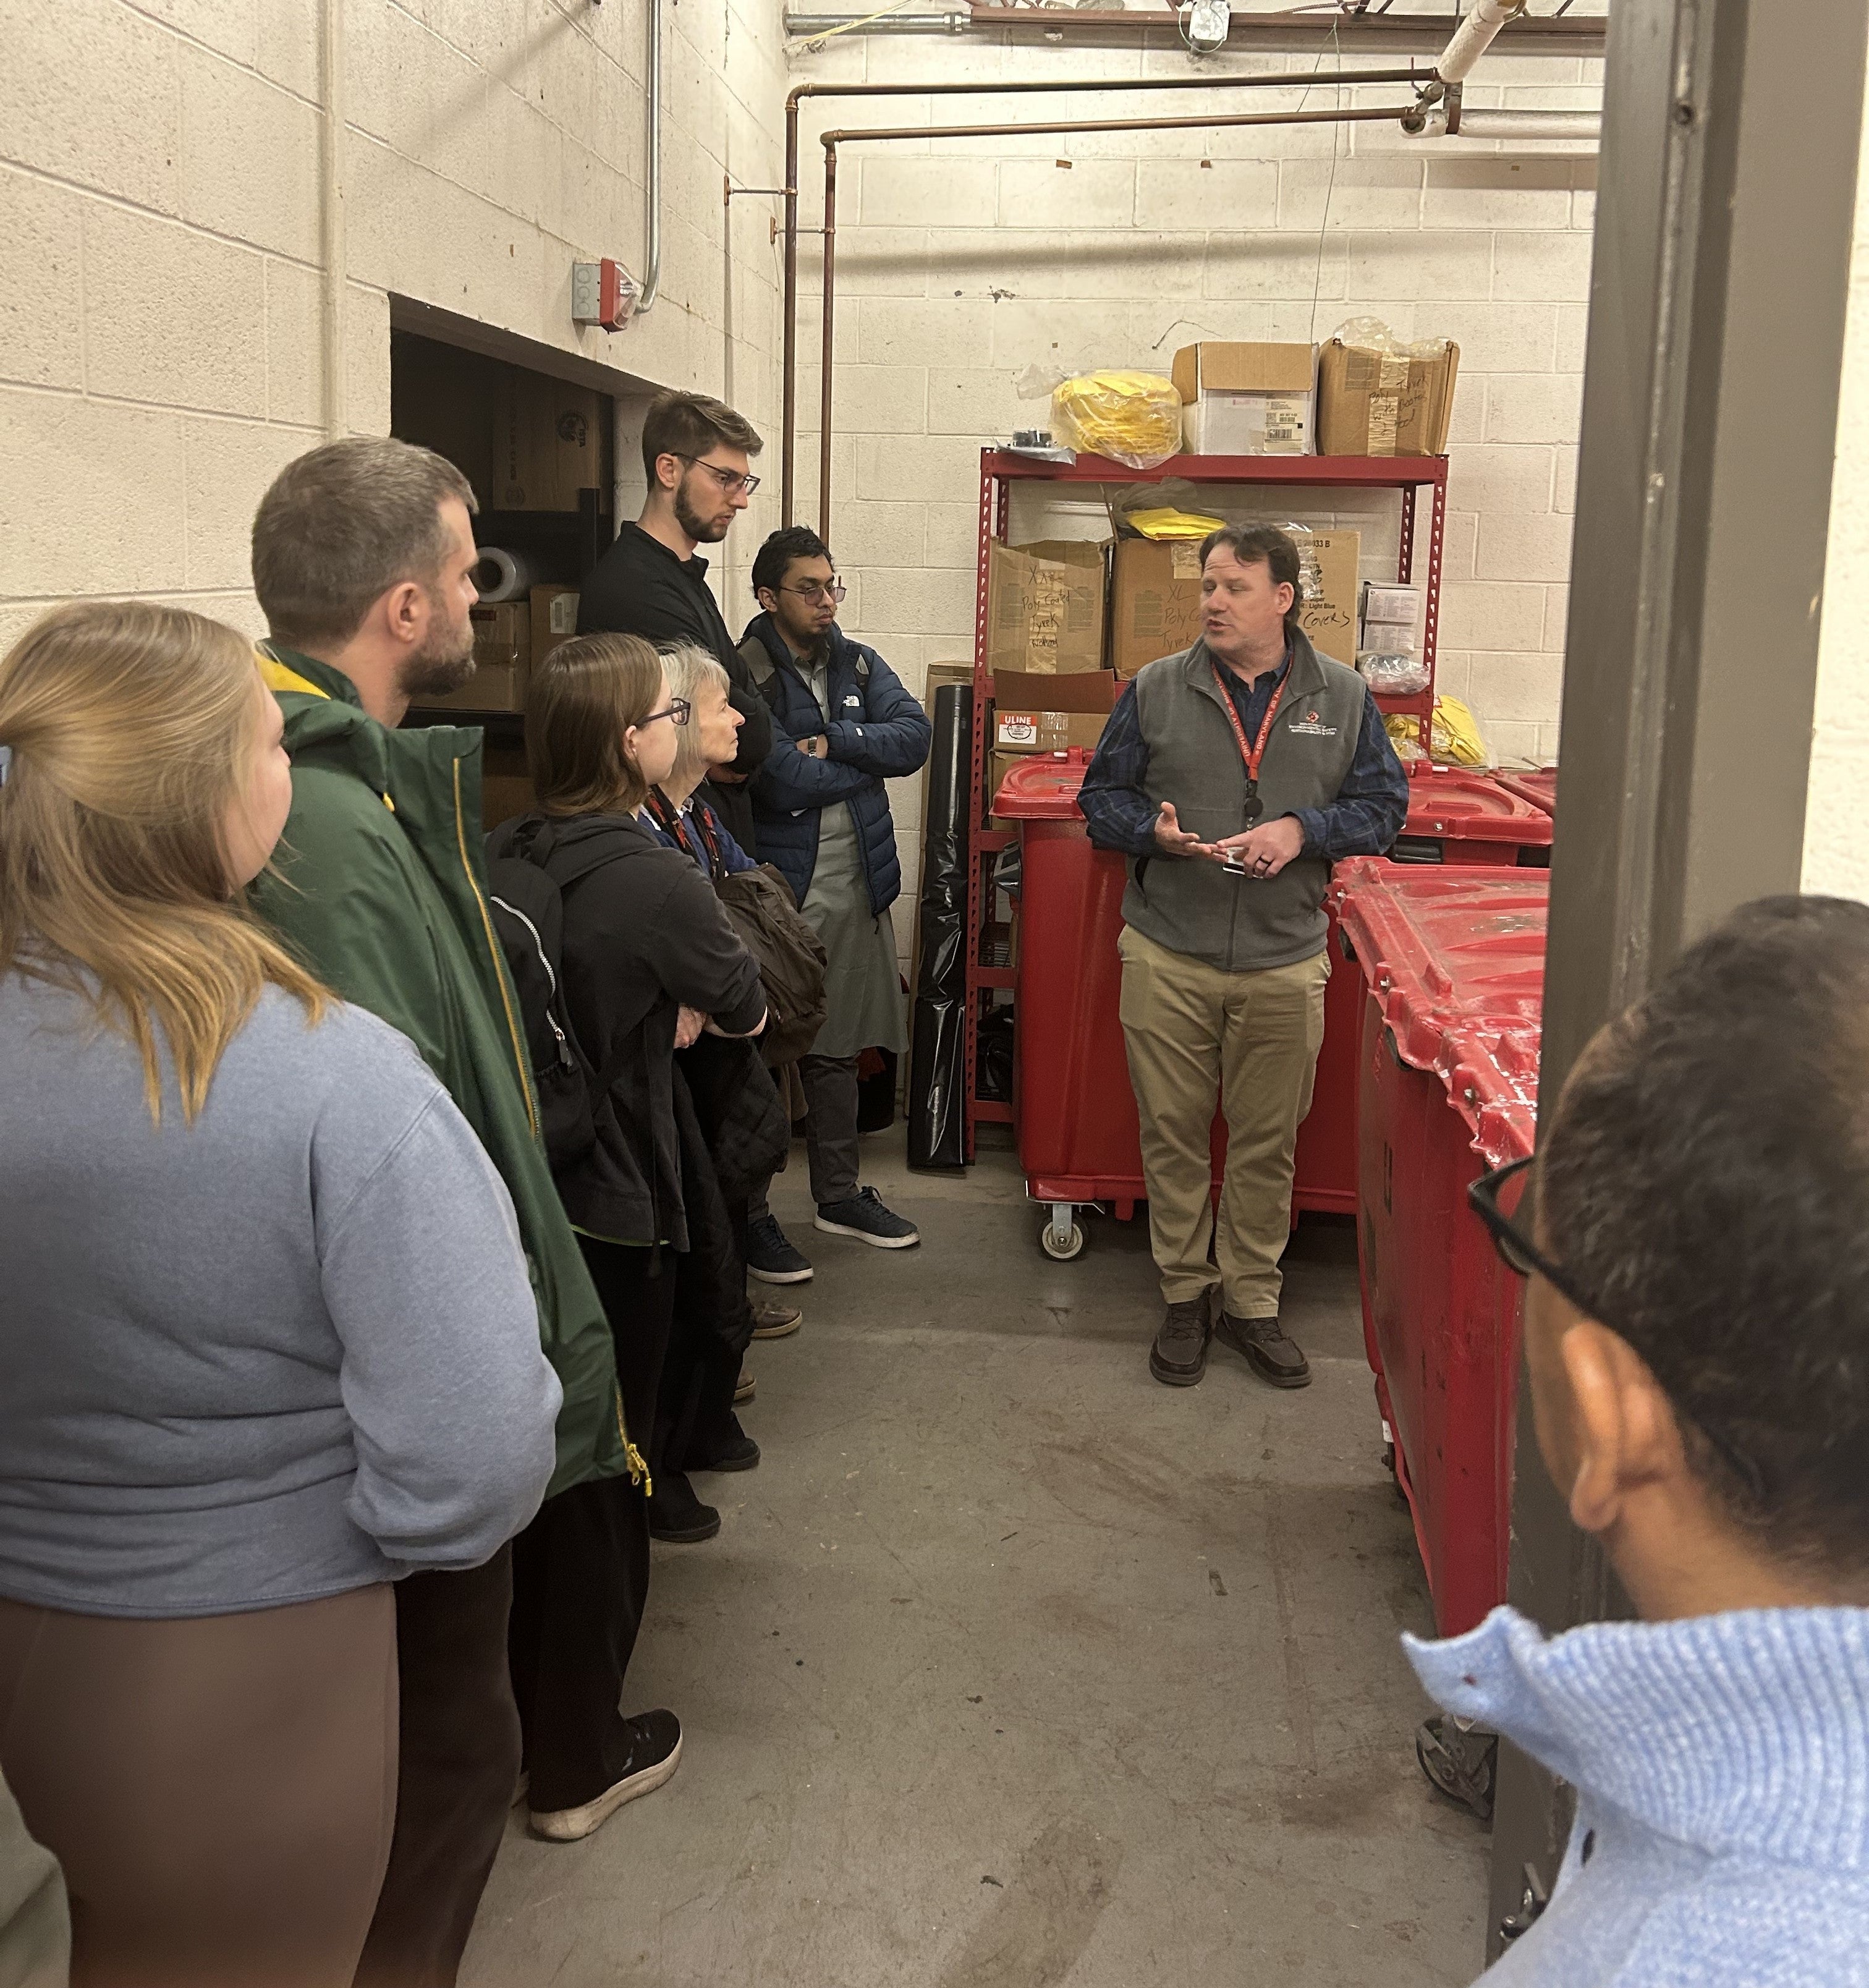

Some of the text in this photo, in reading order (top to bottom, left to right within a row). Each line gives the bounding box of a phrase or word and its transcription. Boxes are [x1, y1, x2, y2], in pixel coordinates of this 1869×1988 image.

[1167, 585, 1195, 603] XL
[1022, 595, 1040, 612] Poly
[1164, 607, 1187, 631] Poly
[1004, 715, 1032, 725] ULINE
[1255, 711, 1273, 749] MARYLAND
